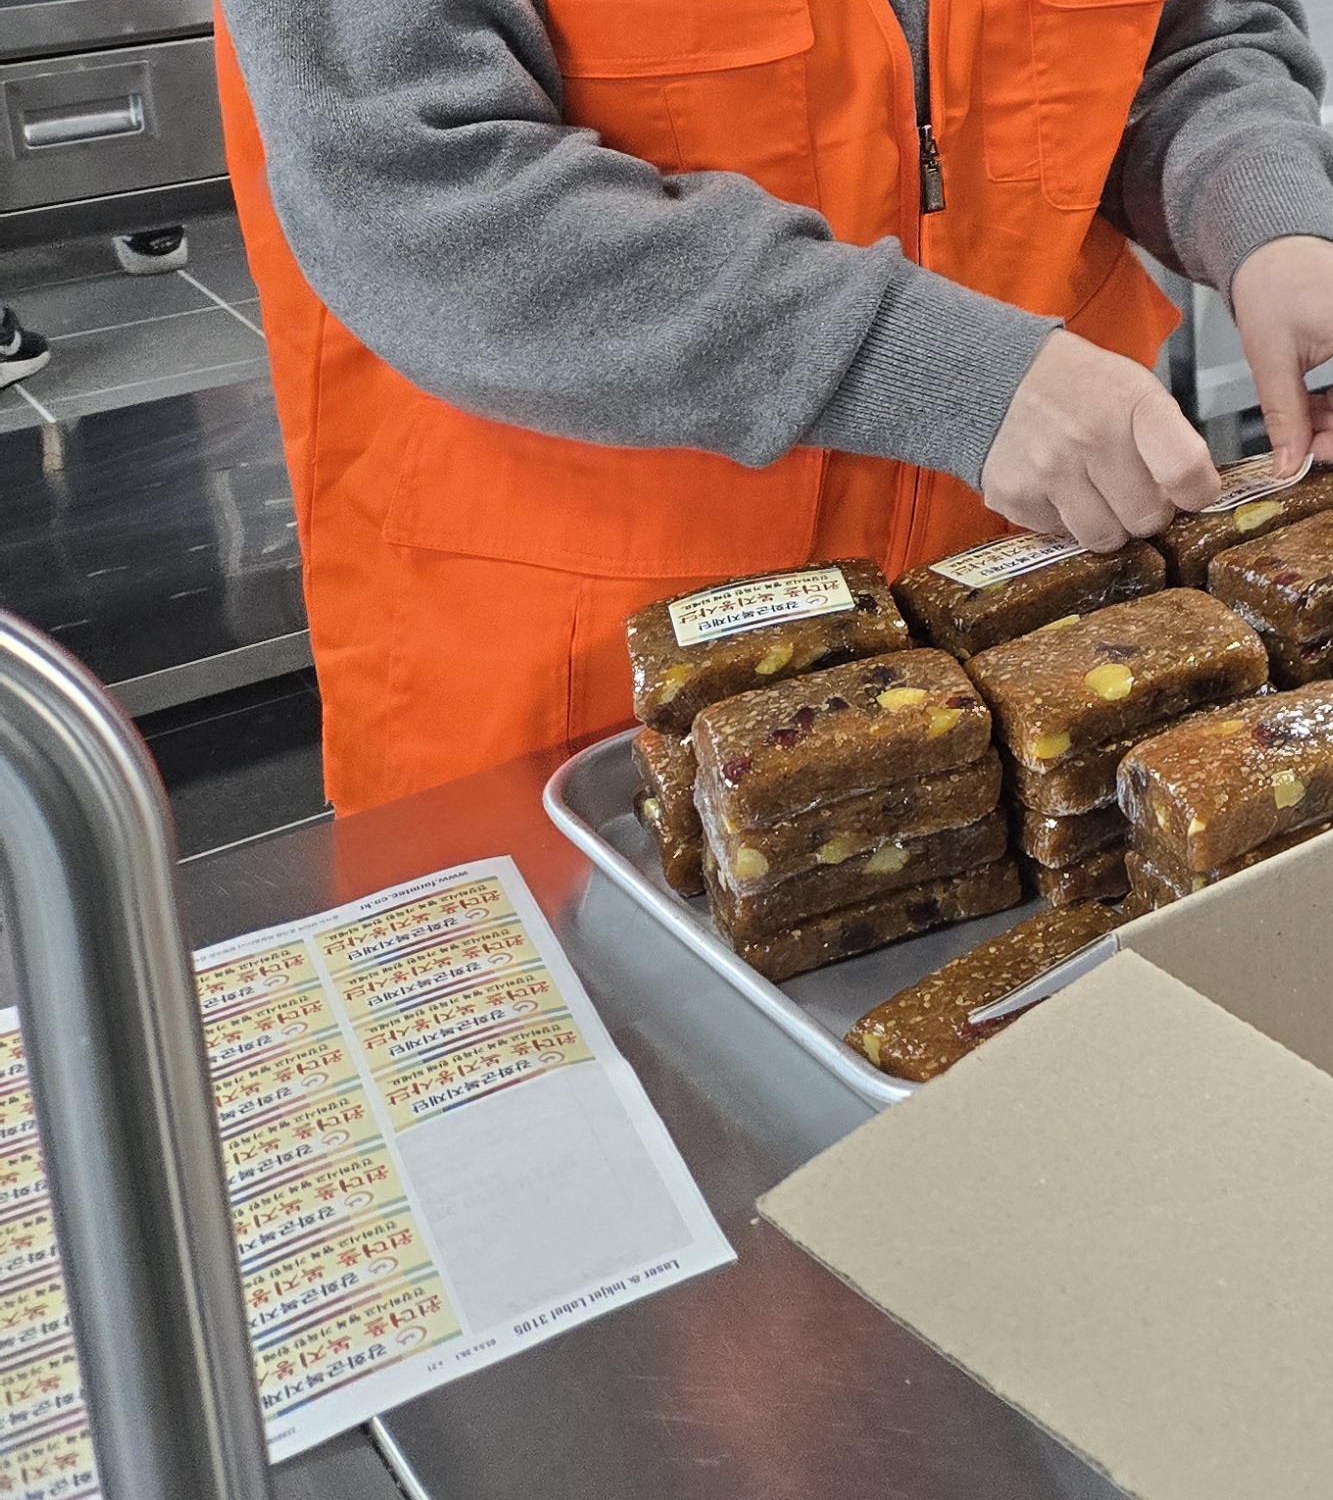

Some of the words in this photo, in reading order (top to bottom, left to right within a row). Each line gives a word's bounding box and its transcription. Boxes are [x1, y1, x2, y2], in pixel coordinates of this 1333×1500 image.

[677, 591, 775, 624] 복지봉사단
[783, 579, 840, 597] 원더풀
[697, 599, 799, 631] 강화군복지재단
[358, 868, 468, 912] www.formtec.co.kr
[437, 887, 501, 917] 원더풀
[321, 908, 431, 957] 복지봉사단
[345, 914, 458, 961] 강화군복지재단
[460, 932, 525, 962] 원더풀
[235, 952, 305, 986] 원더풀
[341, 952, 454, 1003] 복지봉사단
[365, 959, 481, 1008] 강화군복지재단
[483, 979, 550, 1009] 원더풀
[251, 998, 324, 1034] 원더풀
[362, 1000, 477, 1051] 복지봉사단
[386, 1007, 506, 1057] 강화군복지재단
[507, 1029, 578, 1060] 원더풀
[270, 1048, 344, 1085] 원더풀
[384, 1049, 502, 1107] 복지봉사단
[409, 1057, 531, 1114] 강화군복지재단
[290, 1103, 366, 1142] 원더풀
[311, 1163, 390, 1204] 원더풀
[238, 1204, 336, 1253] 강화군복지
[333, 1227, 414, 1269] 원더풀
[242, 1261, 327, 1308] 복지봉
[642, 1258, 679, 1281] Laser
[244, 1270, 359, 1329] 강화군복지
[549, 1296, 586, 1320] Label
[588, 1278, 627, 1304] Inkjet
[360, 1293, 443, 1340] 원더풀
[512, 1313, 548, 1336] 3105
[253, 1332, 354, 1388] 복지봉
[260, 1342, 387, 1409] 강화군복지재
